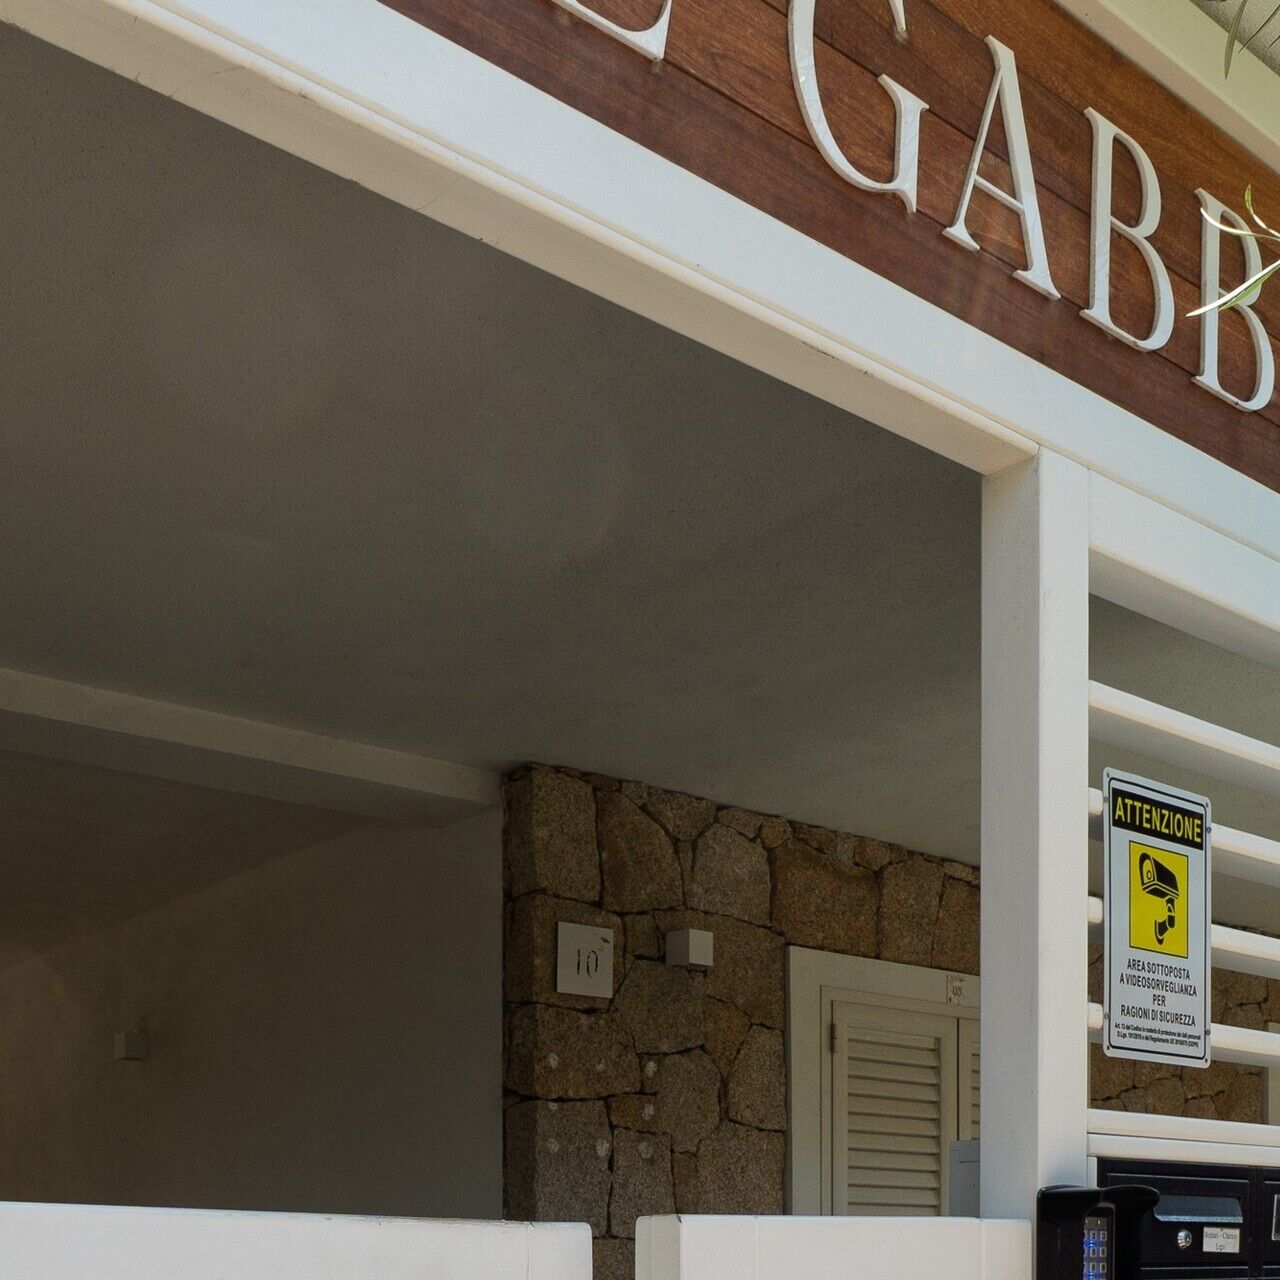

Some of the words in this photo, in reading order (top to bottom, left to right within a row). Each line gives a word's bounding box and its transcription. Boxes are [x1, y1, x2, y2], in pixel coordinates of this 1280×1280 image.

[1114, 796, 1202, 843] ATTENZIONE
[1127, 958, 1146, 973] AREA
[1146, 961, 1191, 980] SOTTOPOSTA
[1119, 973, 1125, 984] A
[1125, 973, 1197, 997] VIDEOSORVEGLIANZA
[1152, 993, 1166, 1007] PER
[1120, 1004, 1150, 1020] RAGIONI
[1151, 1009, 1158, 1021] DI
[1159, 1010, 1197, 1027] SICUREZZA
